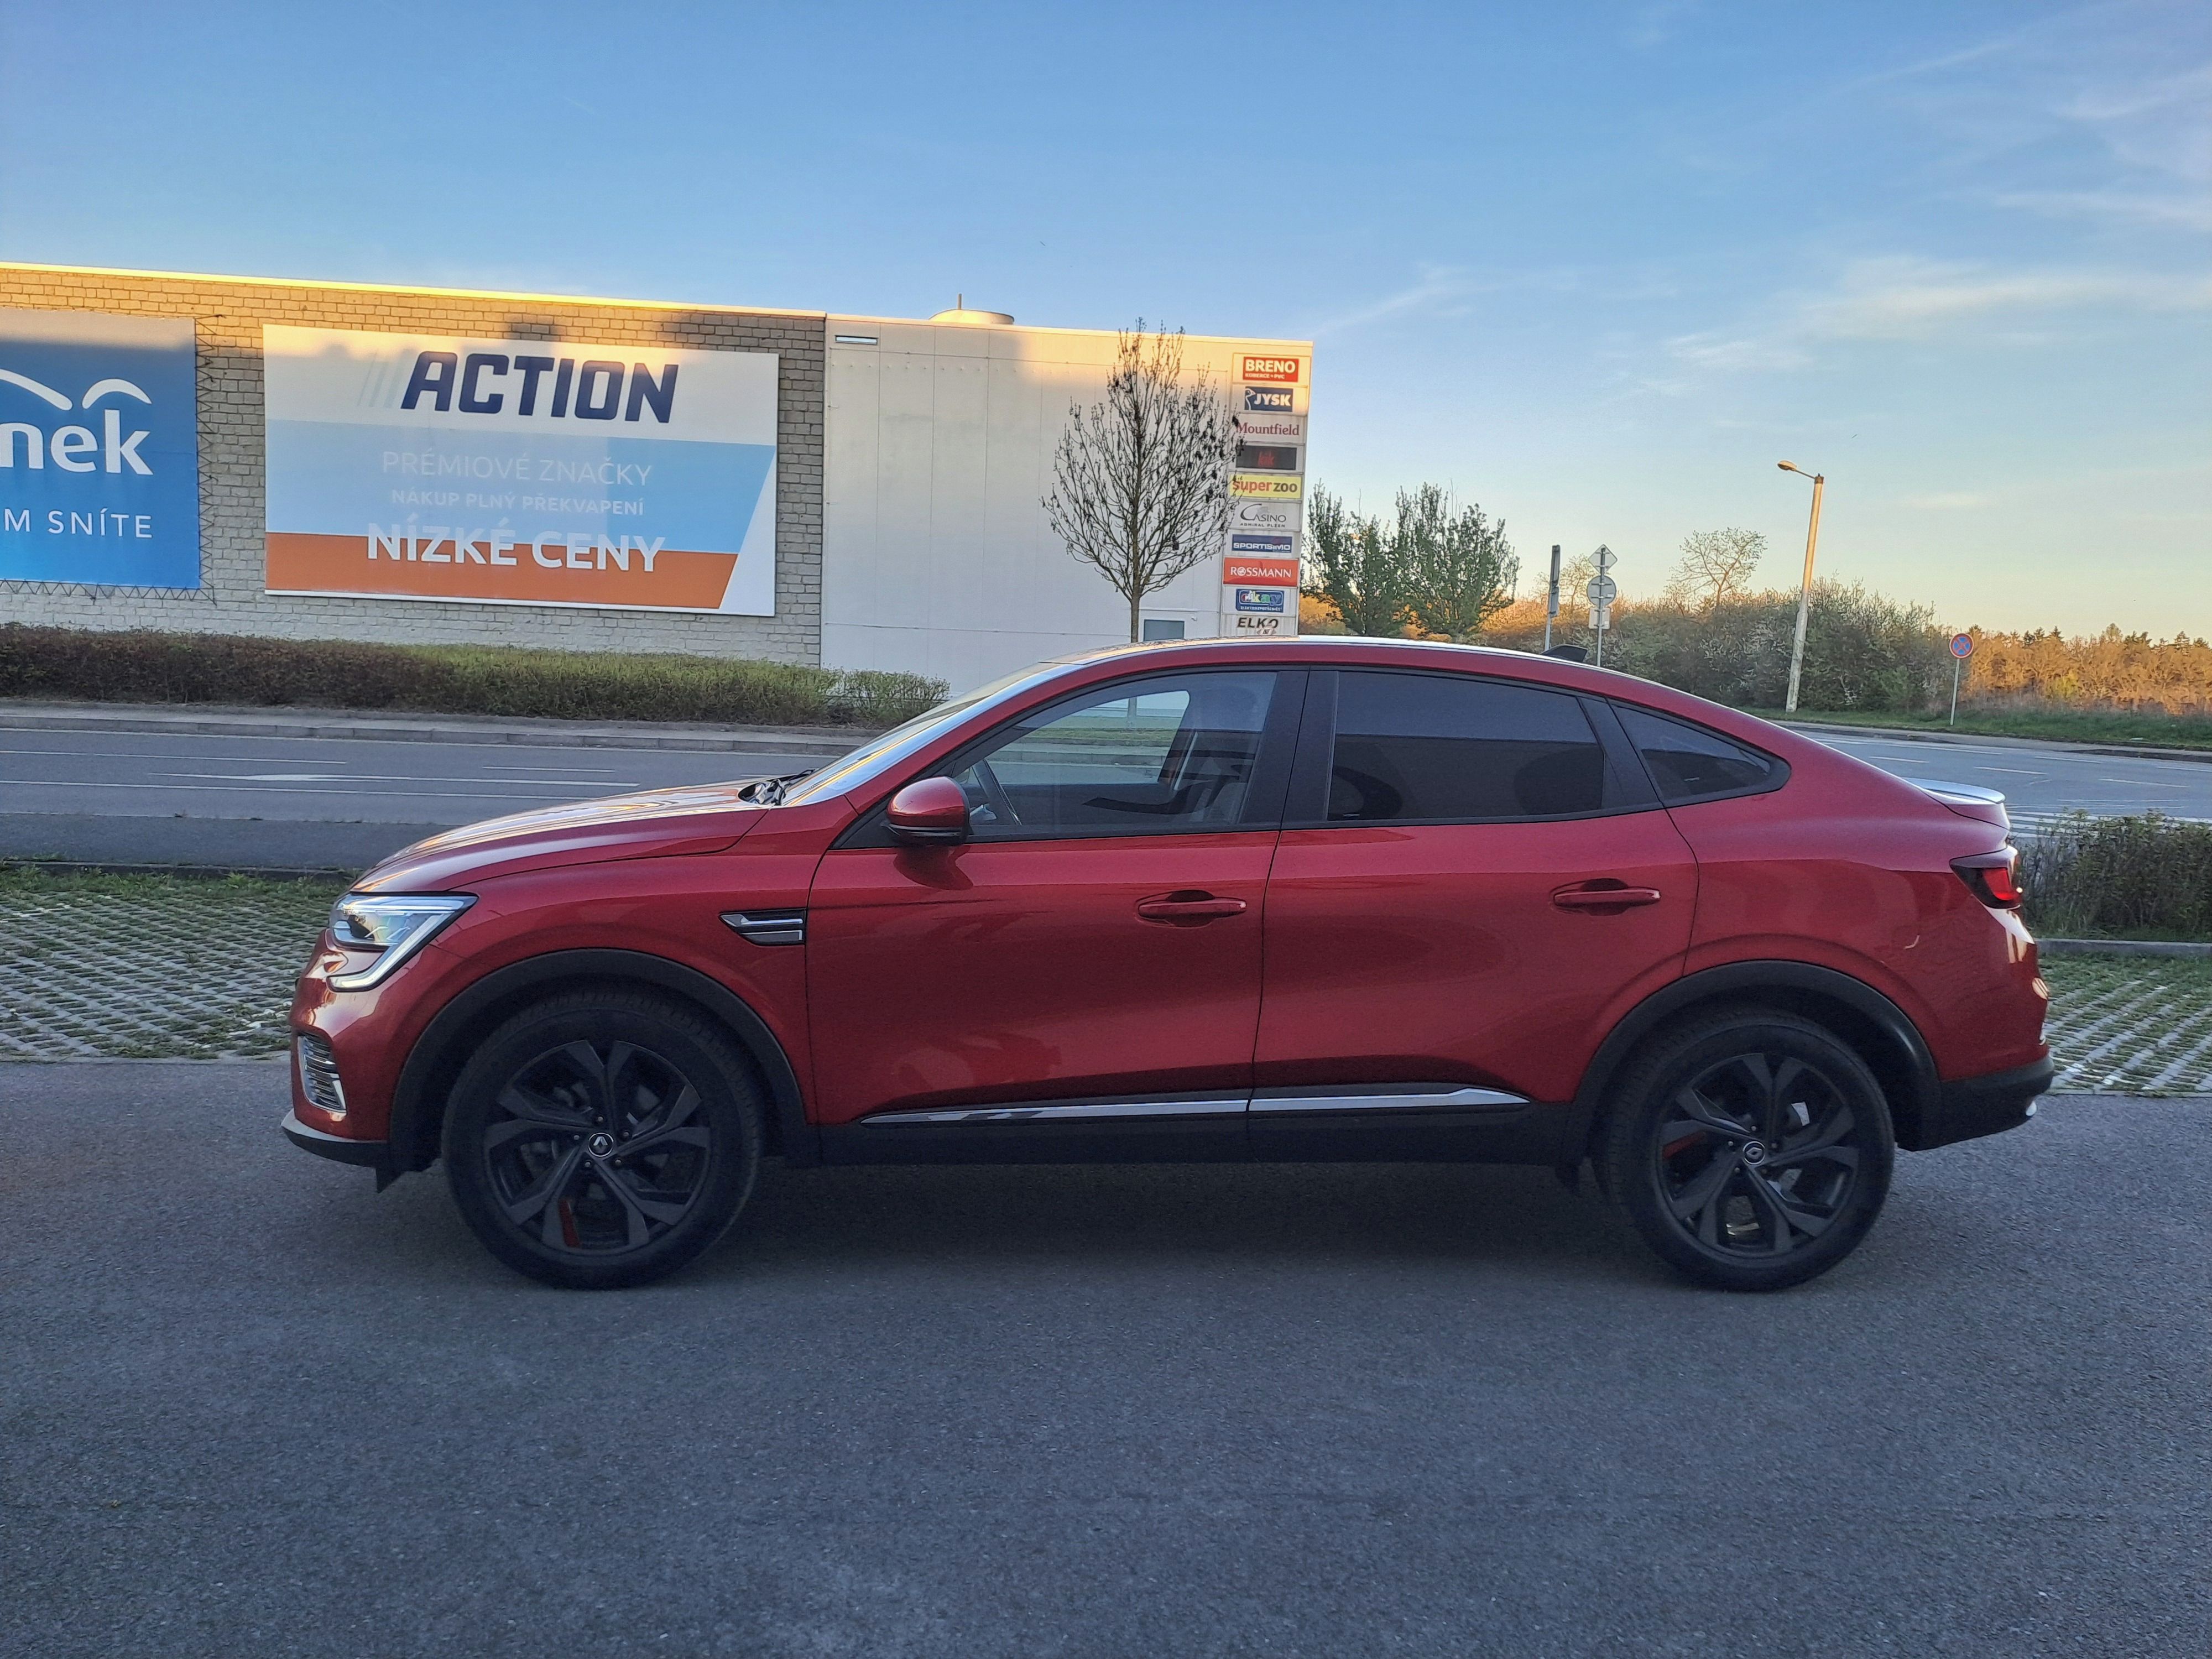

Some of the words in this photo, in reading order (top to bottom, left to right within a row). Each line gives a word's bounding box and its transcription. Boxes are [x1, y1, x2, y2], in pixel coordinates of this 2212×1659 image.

[1245, 358, 1296, 373] BRENO
[400, 351, 679, 424] ACTION
[1254, 393, 1291, 406] JYSK
[1236, 422, 1300, 436] Mountfield
[383, 448, 530, 481] PRÉMIOVÉ
[539, 456, 652, 486] ZNAČKY
[392, 484, 460, 507] NÁKUP
[466, 491, 517, 509] PLNÝ
[523, 493, 644, 515] PŘEKVAPENÍ
[48, 508, 153, 539] SNÍTE
[367, 512, 517, 566] NÍZKÉ
[532, 530, 666, 573] CENY
[1230, 566, 1291, 578] ROSSMANN
